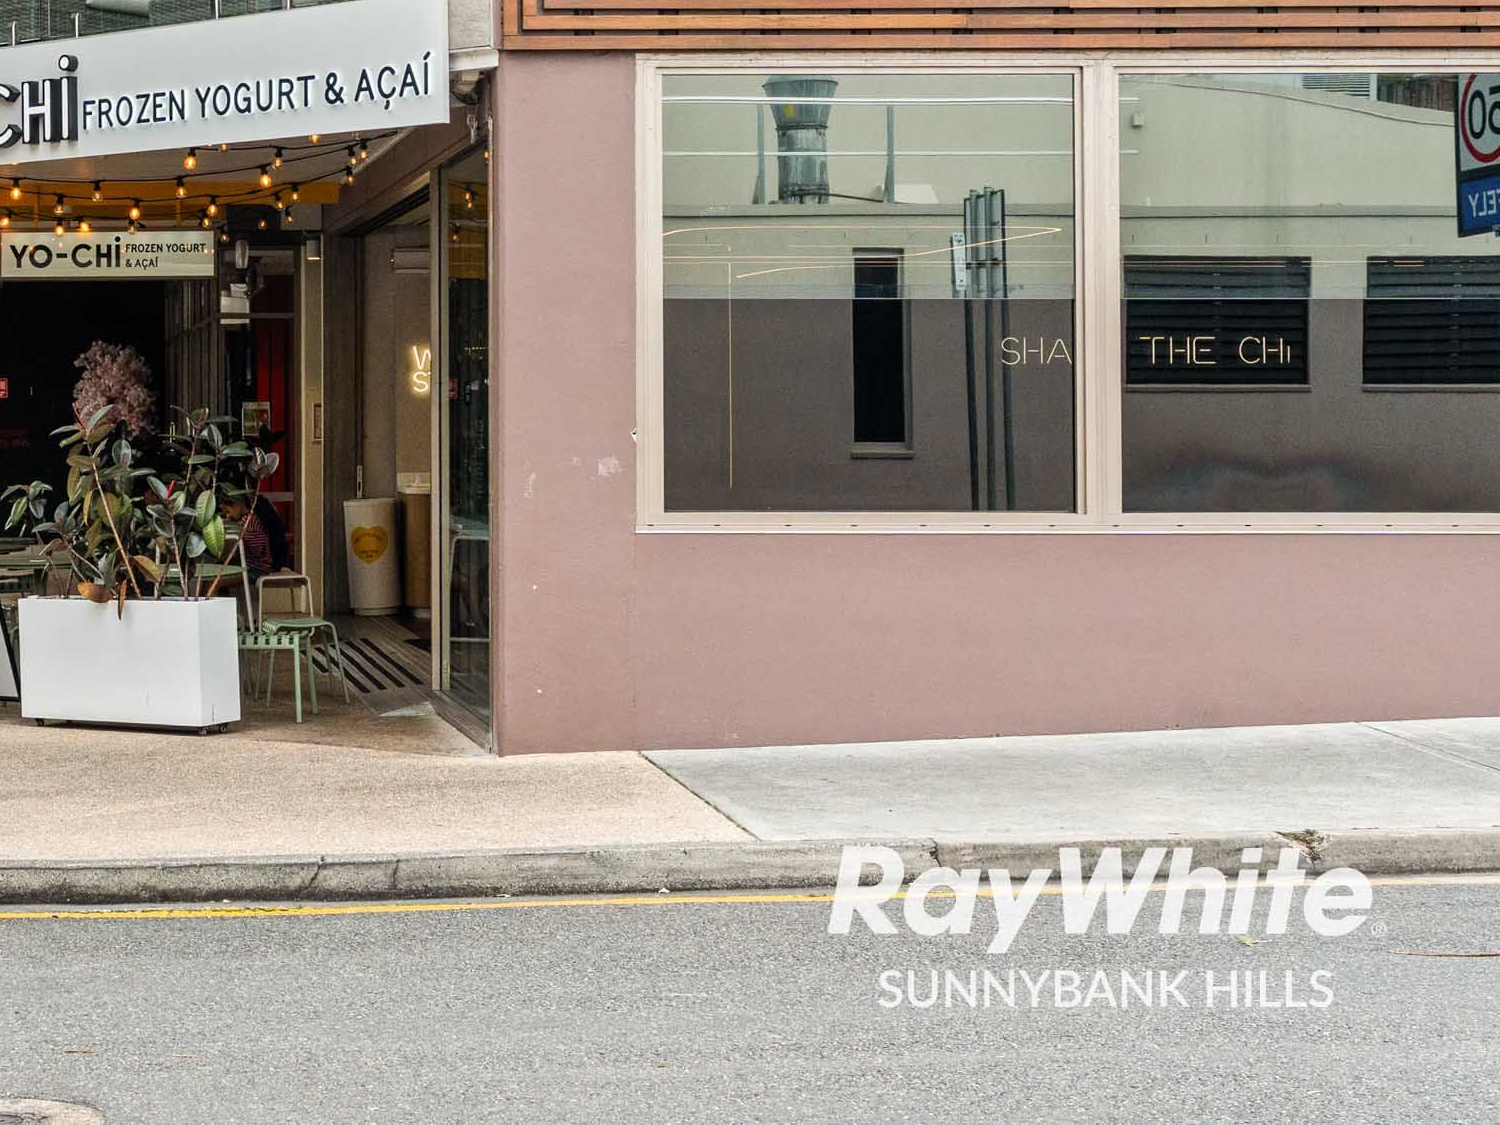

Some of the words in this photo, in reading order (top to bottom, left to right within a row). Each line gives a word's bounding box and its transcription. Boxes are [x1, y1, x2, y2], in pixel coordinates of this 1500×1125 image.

[82, 90, 186, 131] FROZEN
[194, 75, 315, 118] YOGURT
[324, 72, 344, 102] &
[354, 51, 432, 111] AÇAÍ
[125, 243, 163, 252] FROZEN
[167, 243, 206, 253] YOGURT
[135, 256, 158, 270] AÇAÍ
[1140, 336, 1217, 364] THE
